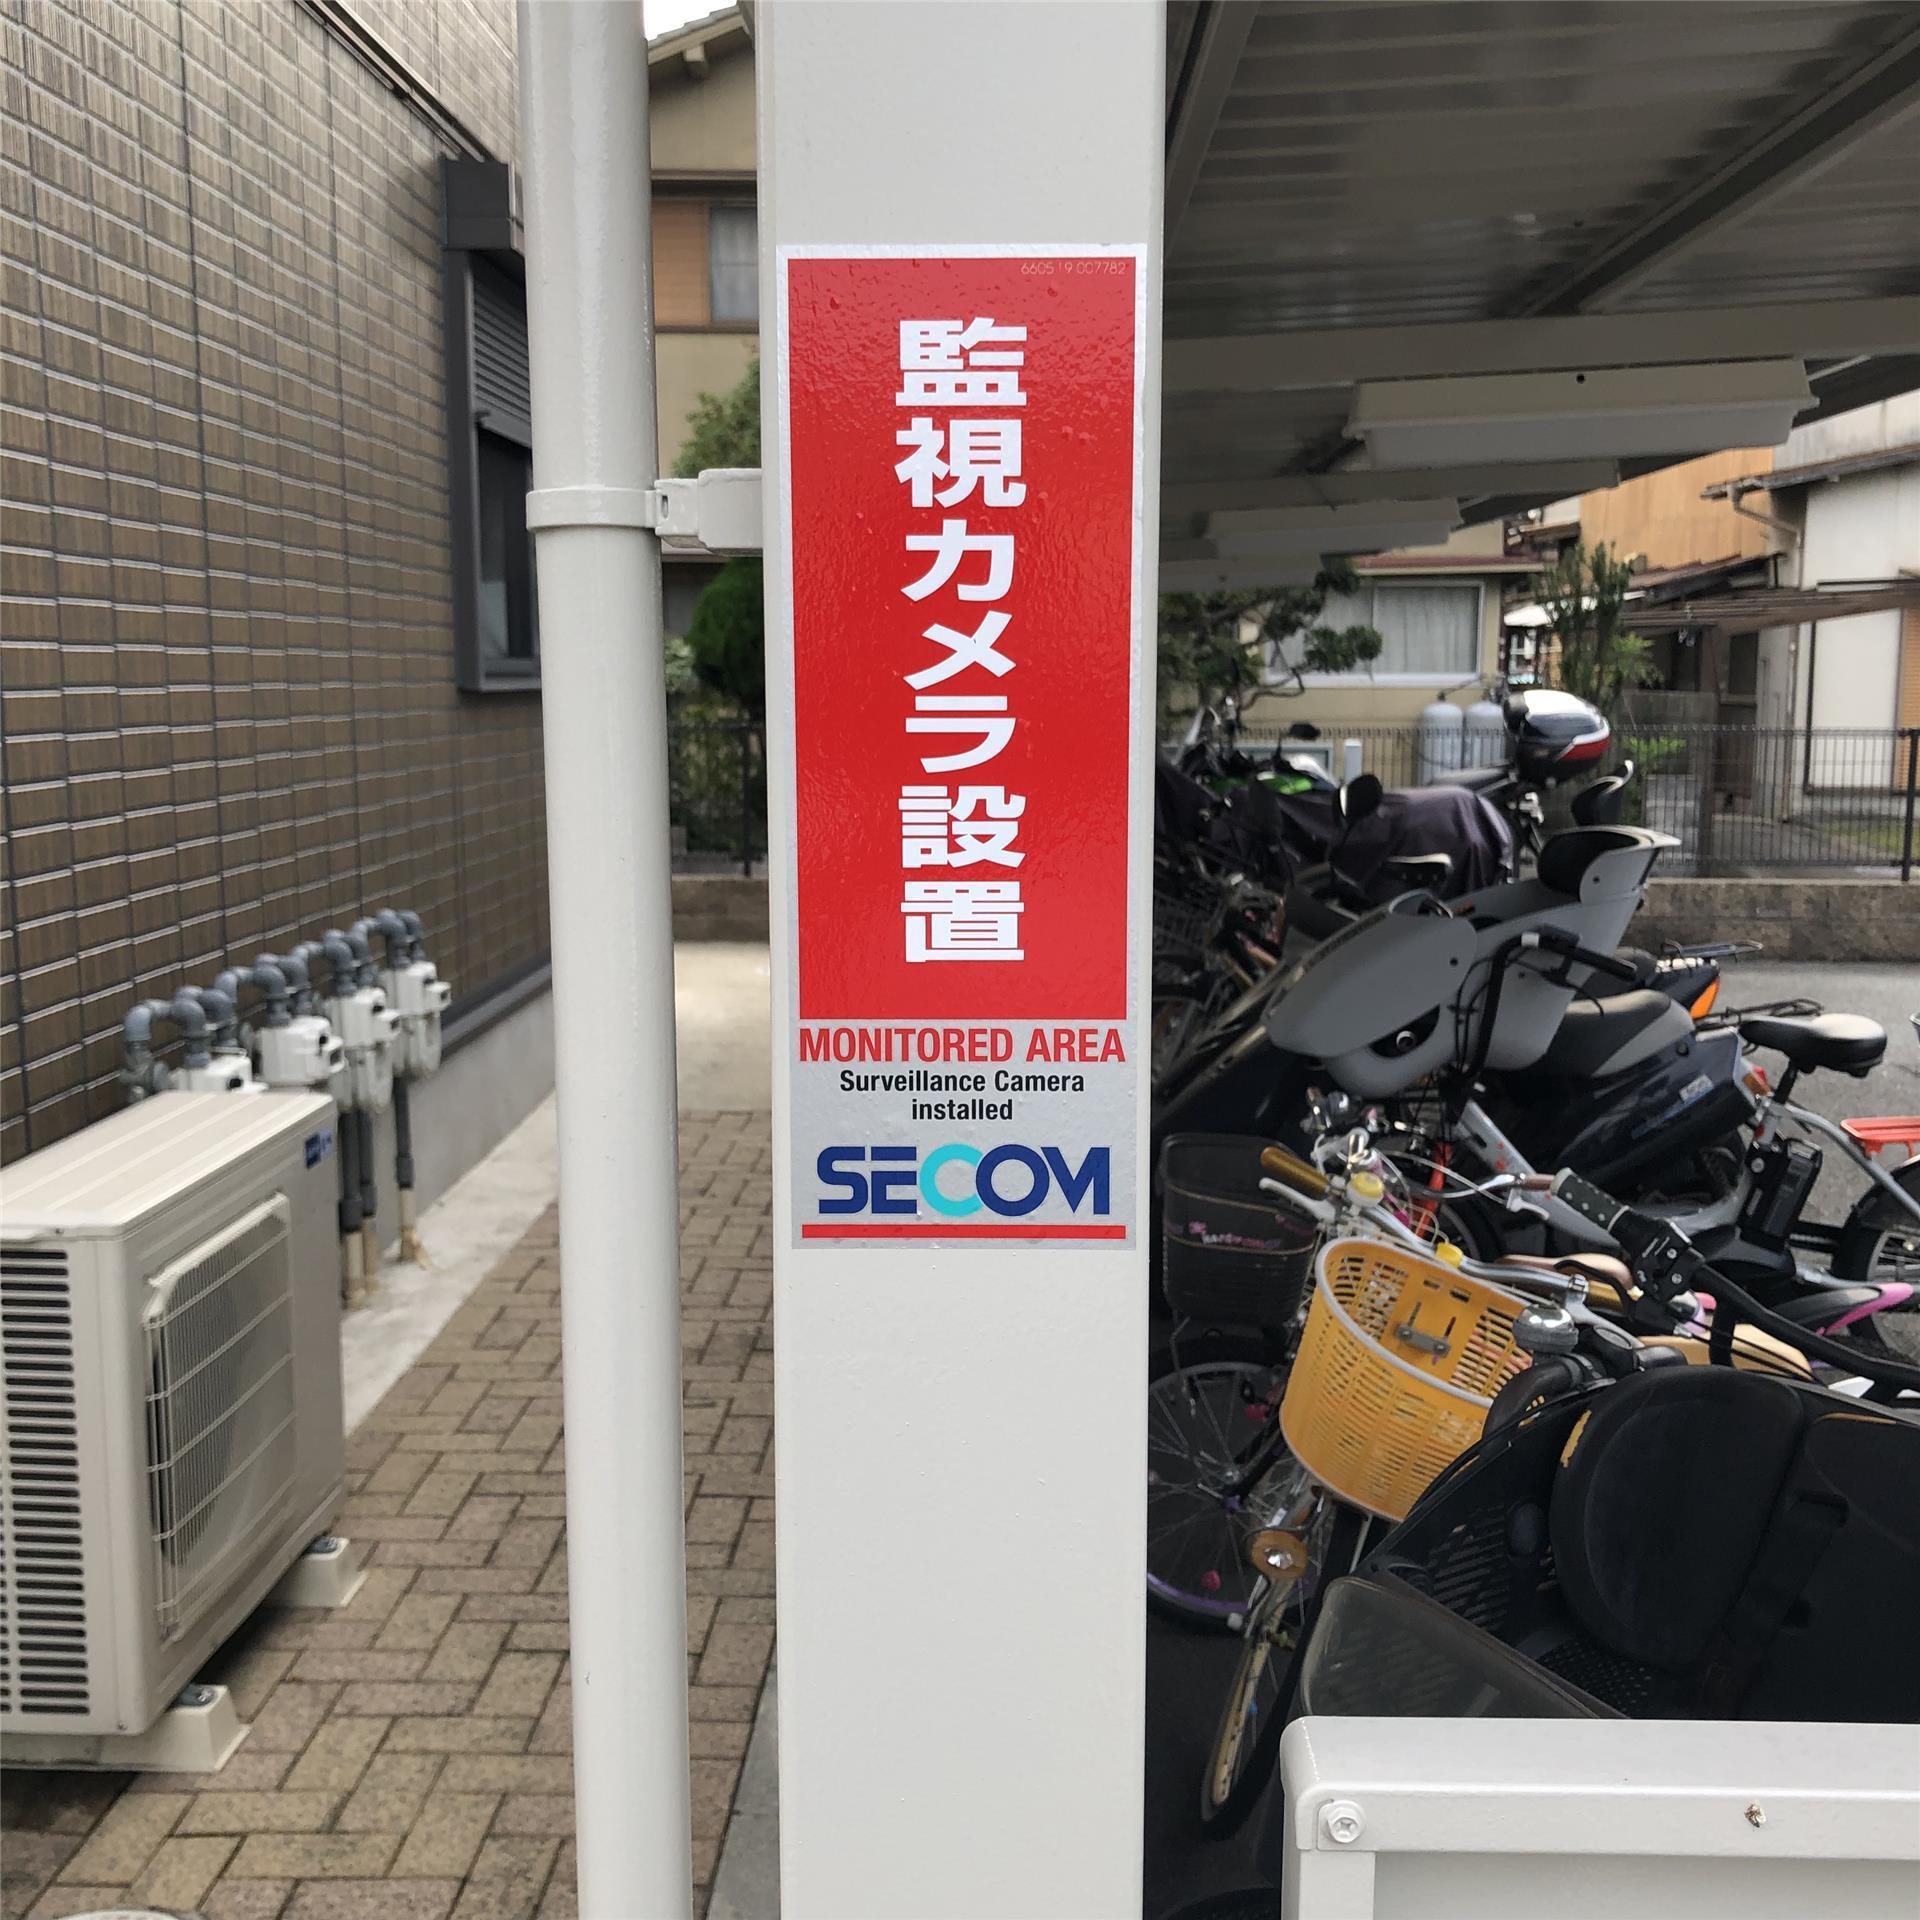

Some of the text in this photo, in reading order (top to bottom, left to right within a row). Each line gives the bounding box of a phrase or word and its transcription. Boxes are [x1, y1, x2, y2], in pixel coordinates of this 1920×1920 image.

[895, 317, 1027, 963] 監視カメラ設置
[800, 1027, 1126, 1063] MONITORED AREA
[840, 1069, 1085, 1092] Surveillance Camera
[912, 1098, 1013, 1120] installed
[816, 1143, 1110, 1217] SECOM
